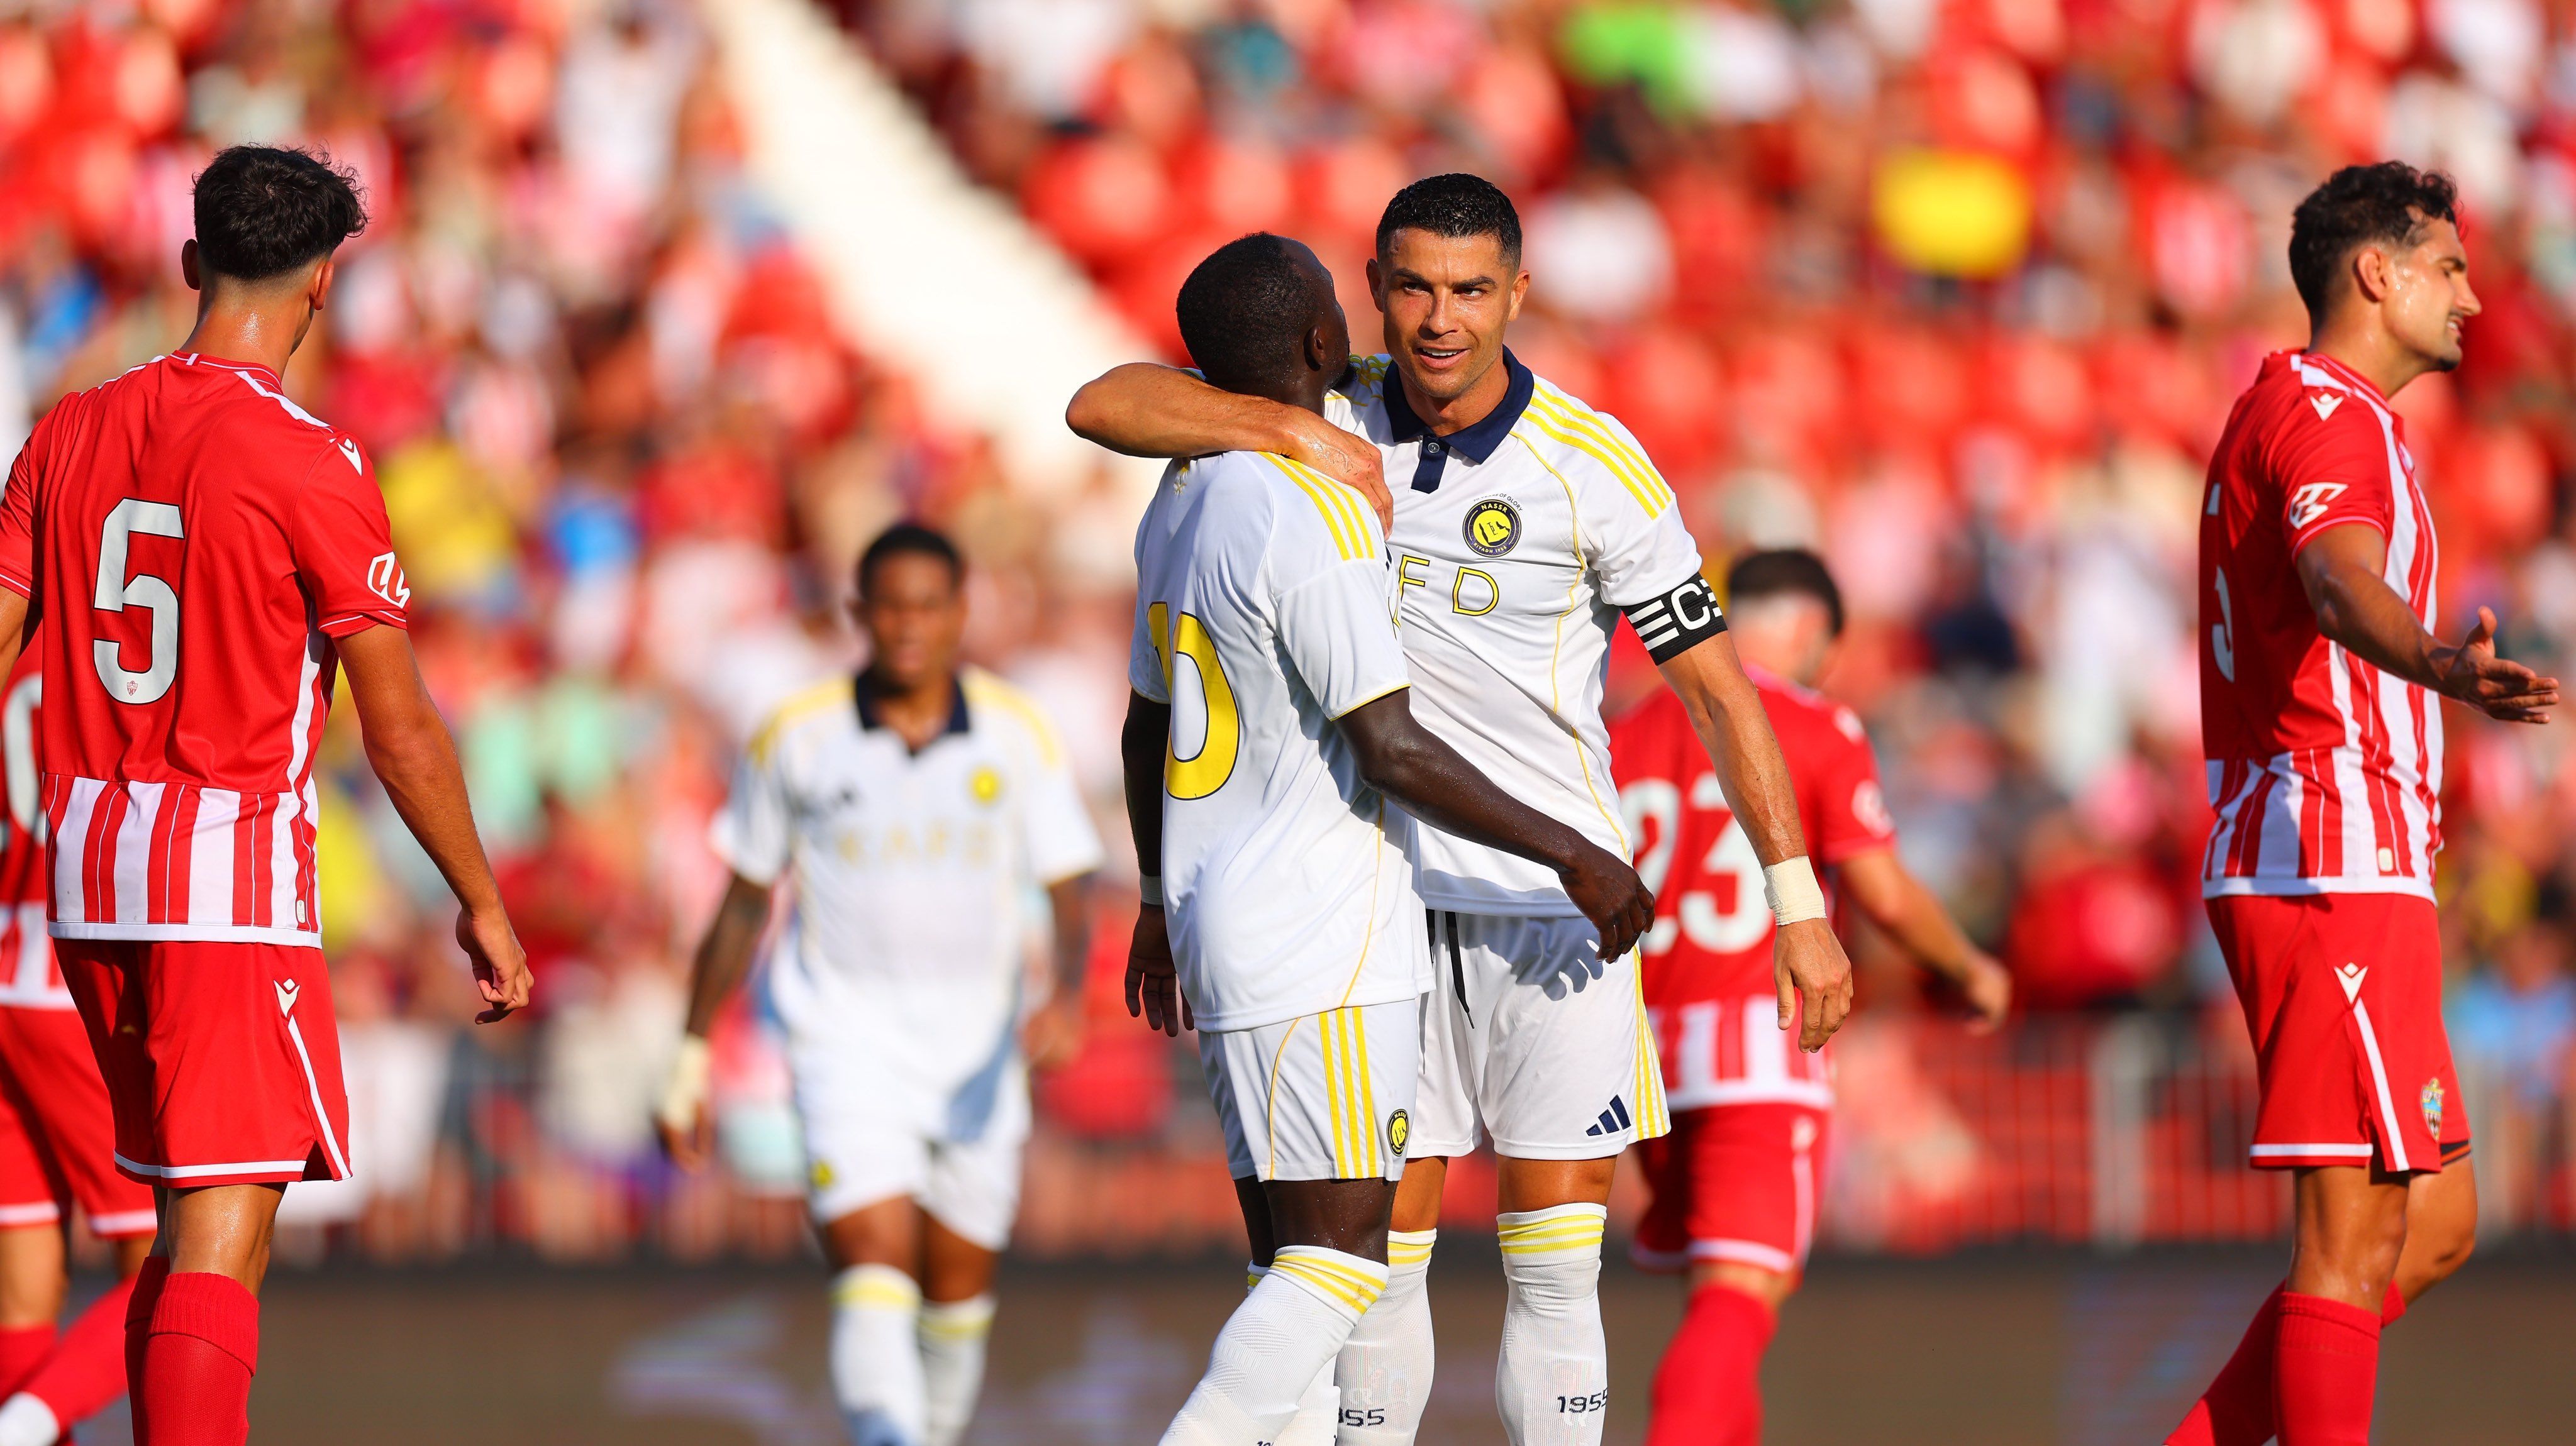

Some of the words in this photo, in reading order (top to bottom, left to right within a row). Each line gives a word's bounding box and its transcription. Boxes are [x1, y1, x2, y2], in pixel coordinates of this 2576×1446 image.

[1481, 504, 1507, 512] NASSR
[1507, 496, 1523, 511] GLORY
[1474, 543, 1493, 553] RIYADH
[94, 497, 185, 705] 5
[1670, 582, 1711, 631] C
[1621, 771, 1776, 954] 23
[1338, 1408, 1385, 1427] 55
